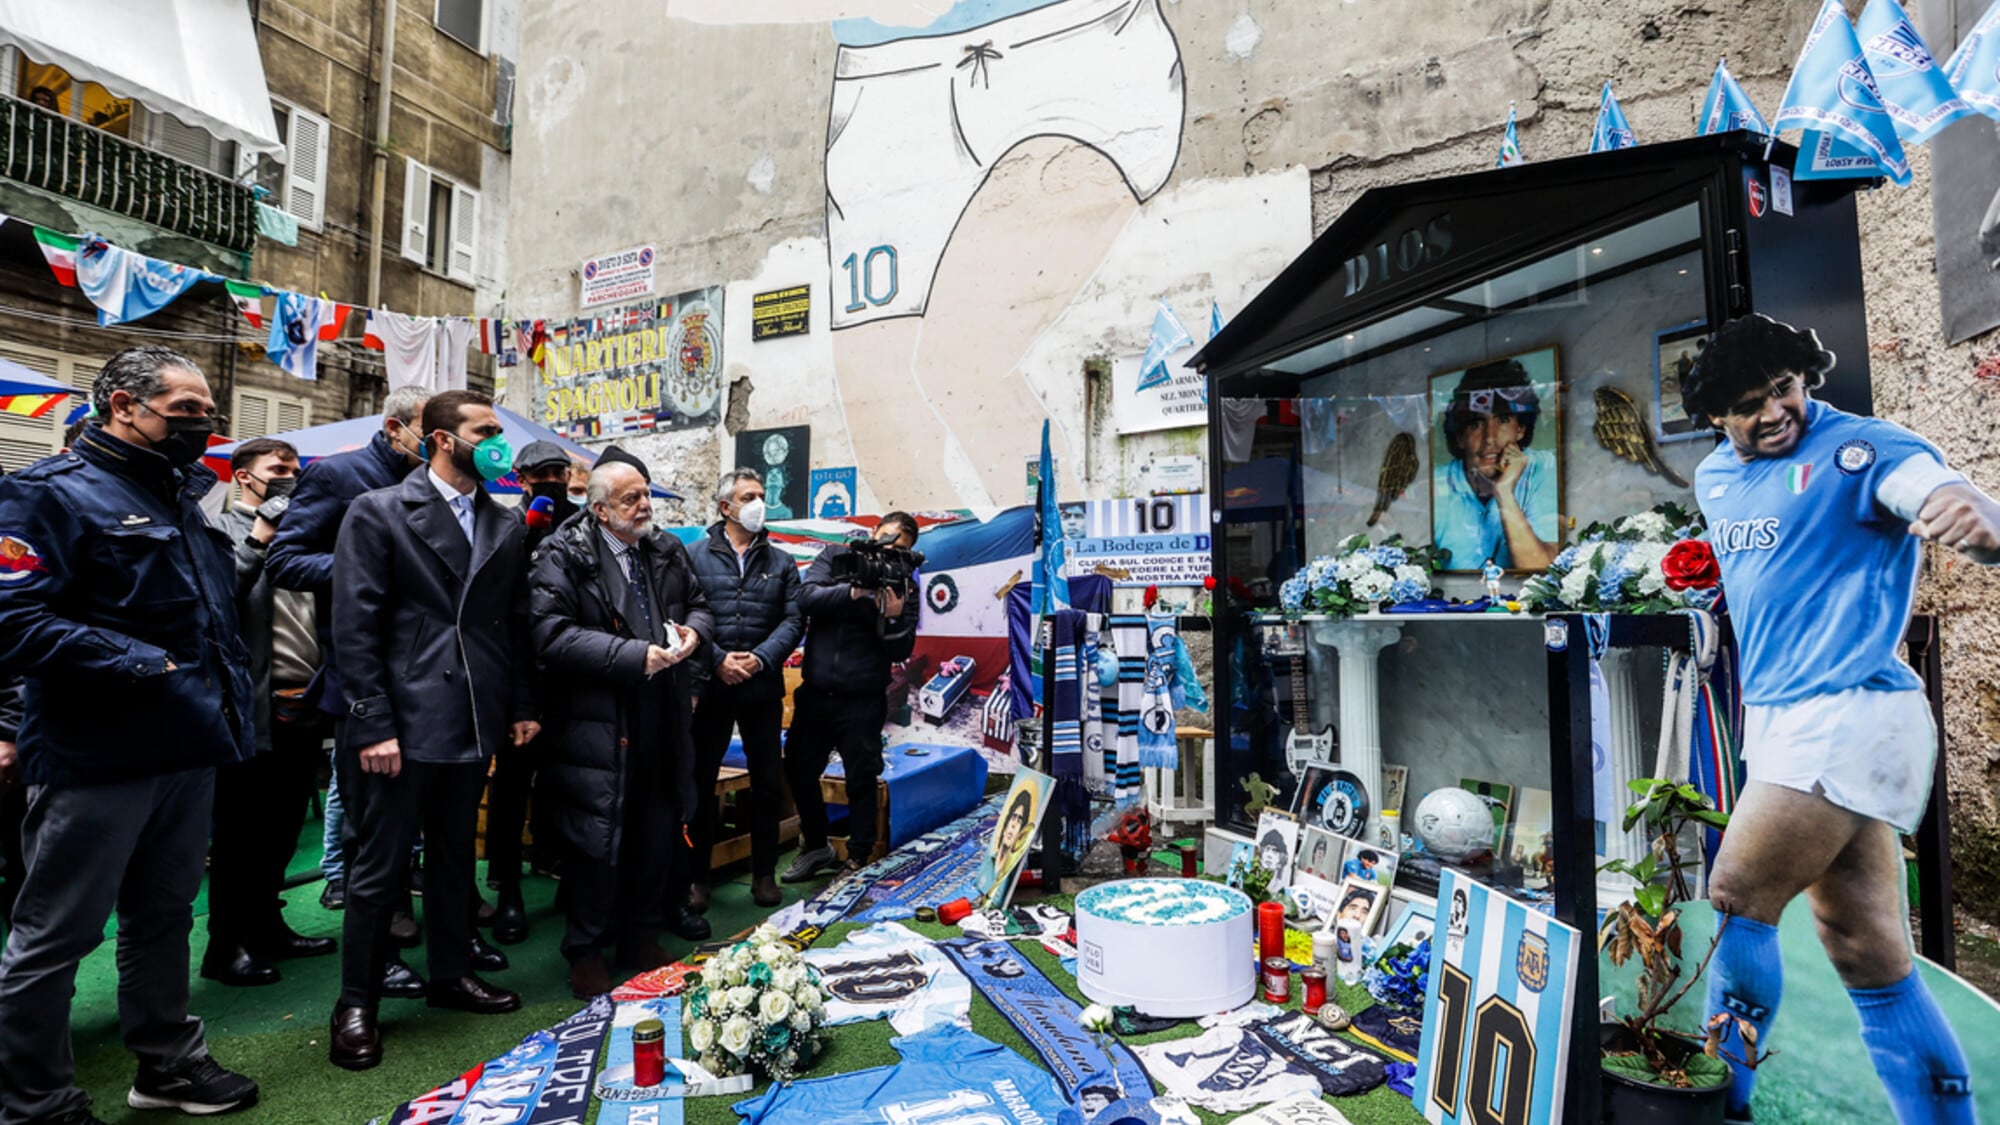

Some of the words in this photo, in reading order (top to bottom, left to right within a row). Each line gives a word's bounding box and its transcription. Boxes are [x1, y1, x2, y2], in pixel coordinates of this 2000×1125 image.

[842, 244, 899, 314] 10
[1343, 212, 1453, 298] DIOS
[587, 286, 649, 303] PARCHEGGIATE
[544, 325, 668, 386] QUARTIERI
[545, 372, 662, 423] SPAGNOLI
[1135, 500, 1176, 534] 10
[1076, 540, 1096, 553] La
[1102, 536, 1164, 553] Bodega
[1169, 536, 1190, 550] de
[1119, 558, 1140, 566] SUL
[1142, 557, 1181, 565] CODICE
[1136, 573, 1182, 581] NOSTRA
[819, 949, 929, 1004] 10
[1429, 960, 1538, 1125] 10
